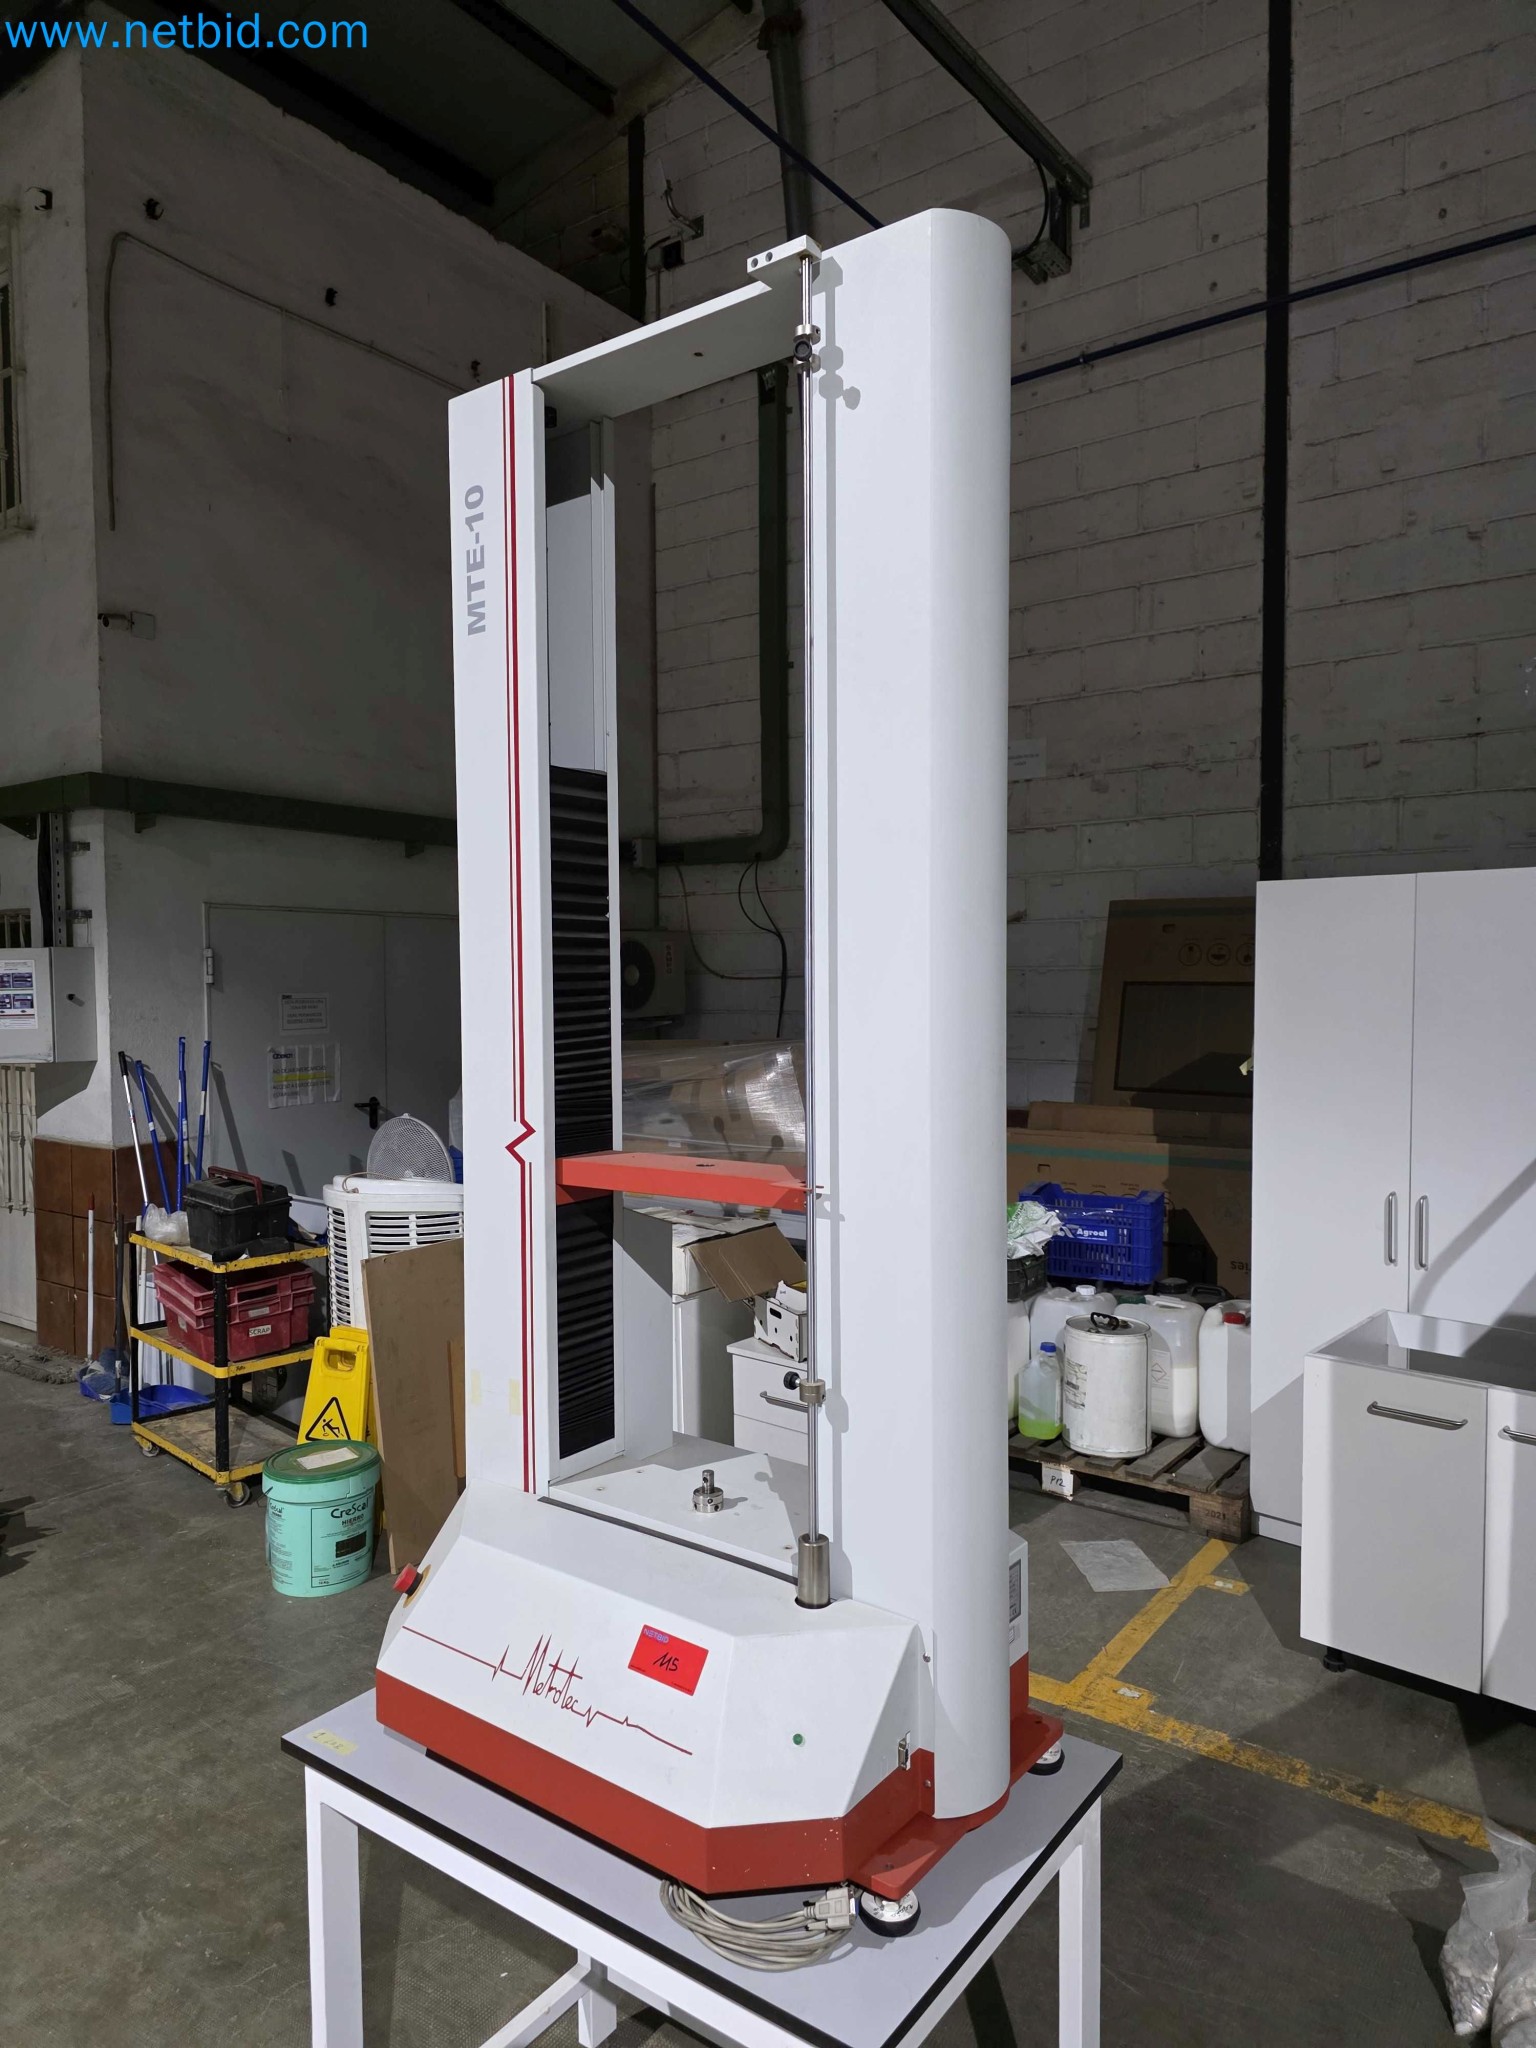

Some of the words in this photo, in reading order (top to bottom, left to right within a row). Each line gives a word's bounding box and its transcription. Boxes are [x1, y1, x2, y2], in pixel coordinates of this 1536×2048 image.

[465, 485, 486, 636] MTE-10
[249, 1327, 270, 1336] SCRAP
[331, 1497, 369, 1518] CreScal
